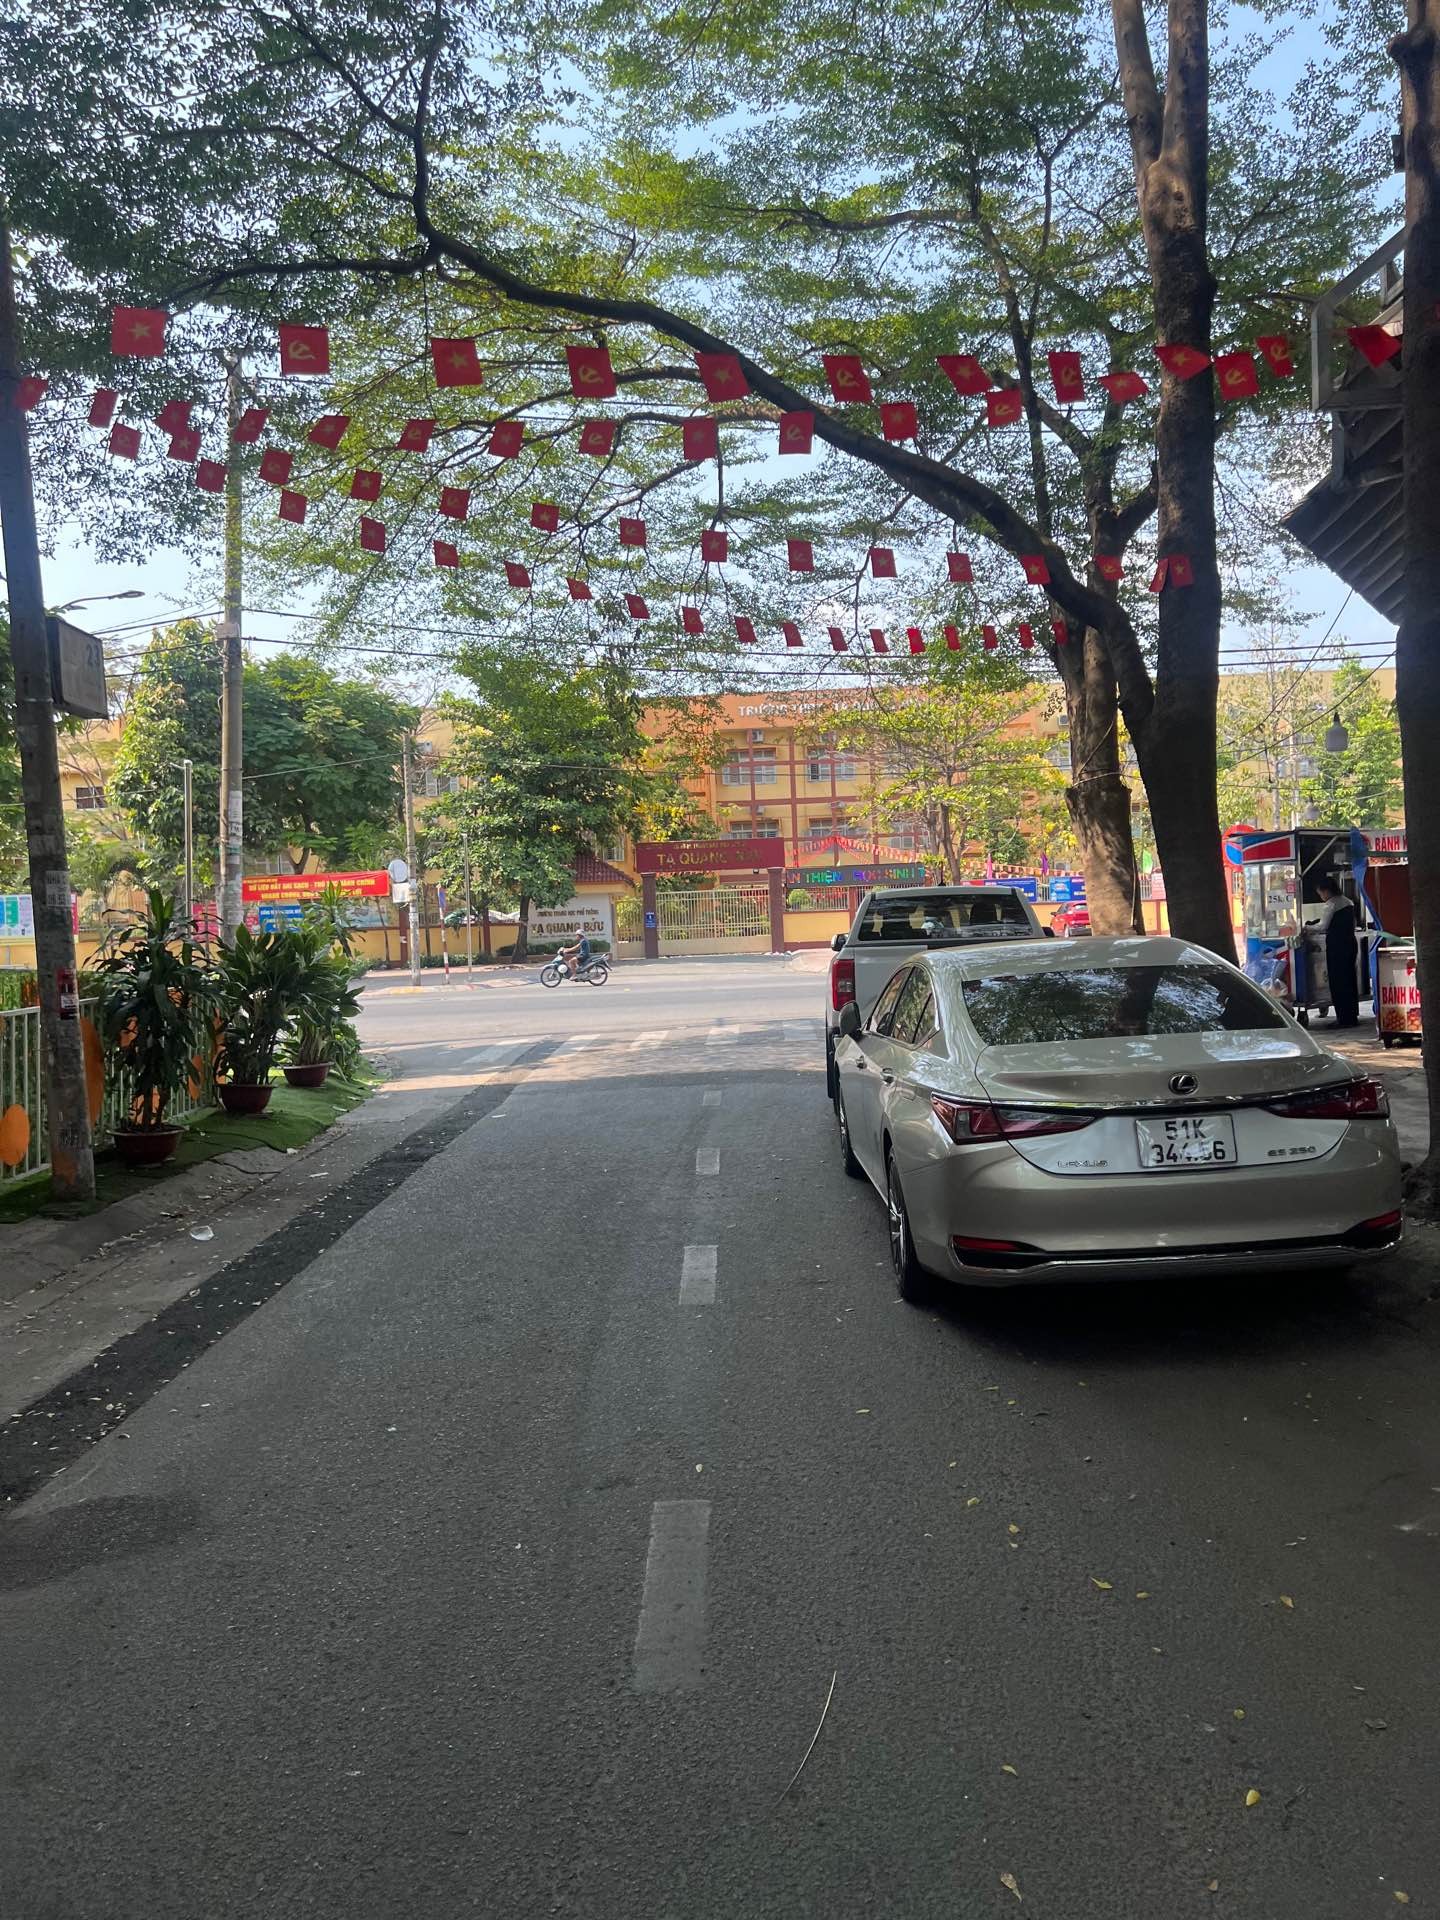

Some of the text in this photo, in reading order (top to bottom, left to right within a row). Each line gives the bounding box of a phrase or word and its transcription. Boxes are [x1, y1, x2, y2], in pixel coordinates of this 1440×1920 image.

[1375, 833, 1400, 852] BÁNH
[546, 921, 582, 935] QUANG
[1382, 982, 1406, 1004] BÁNH
[1164, 1119, 1207, 1140] 51K
[1267, 1145, 1317, 1157] ES 250
[1057, 1159, 1109, 1168] LEXUS
